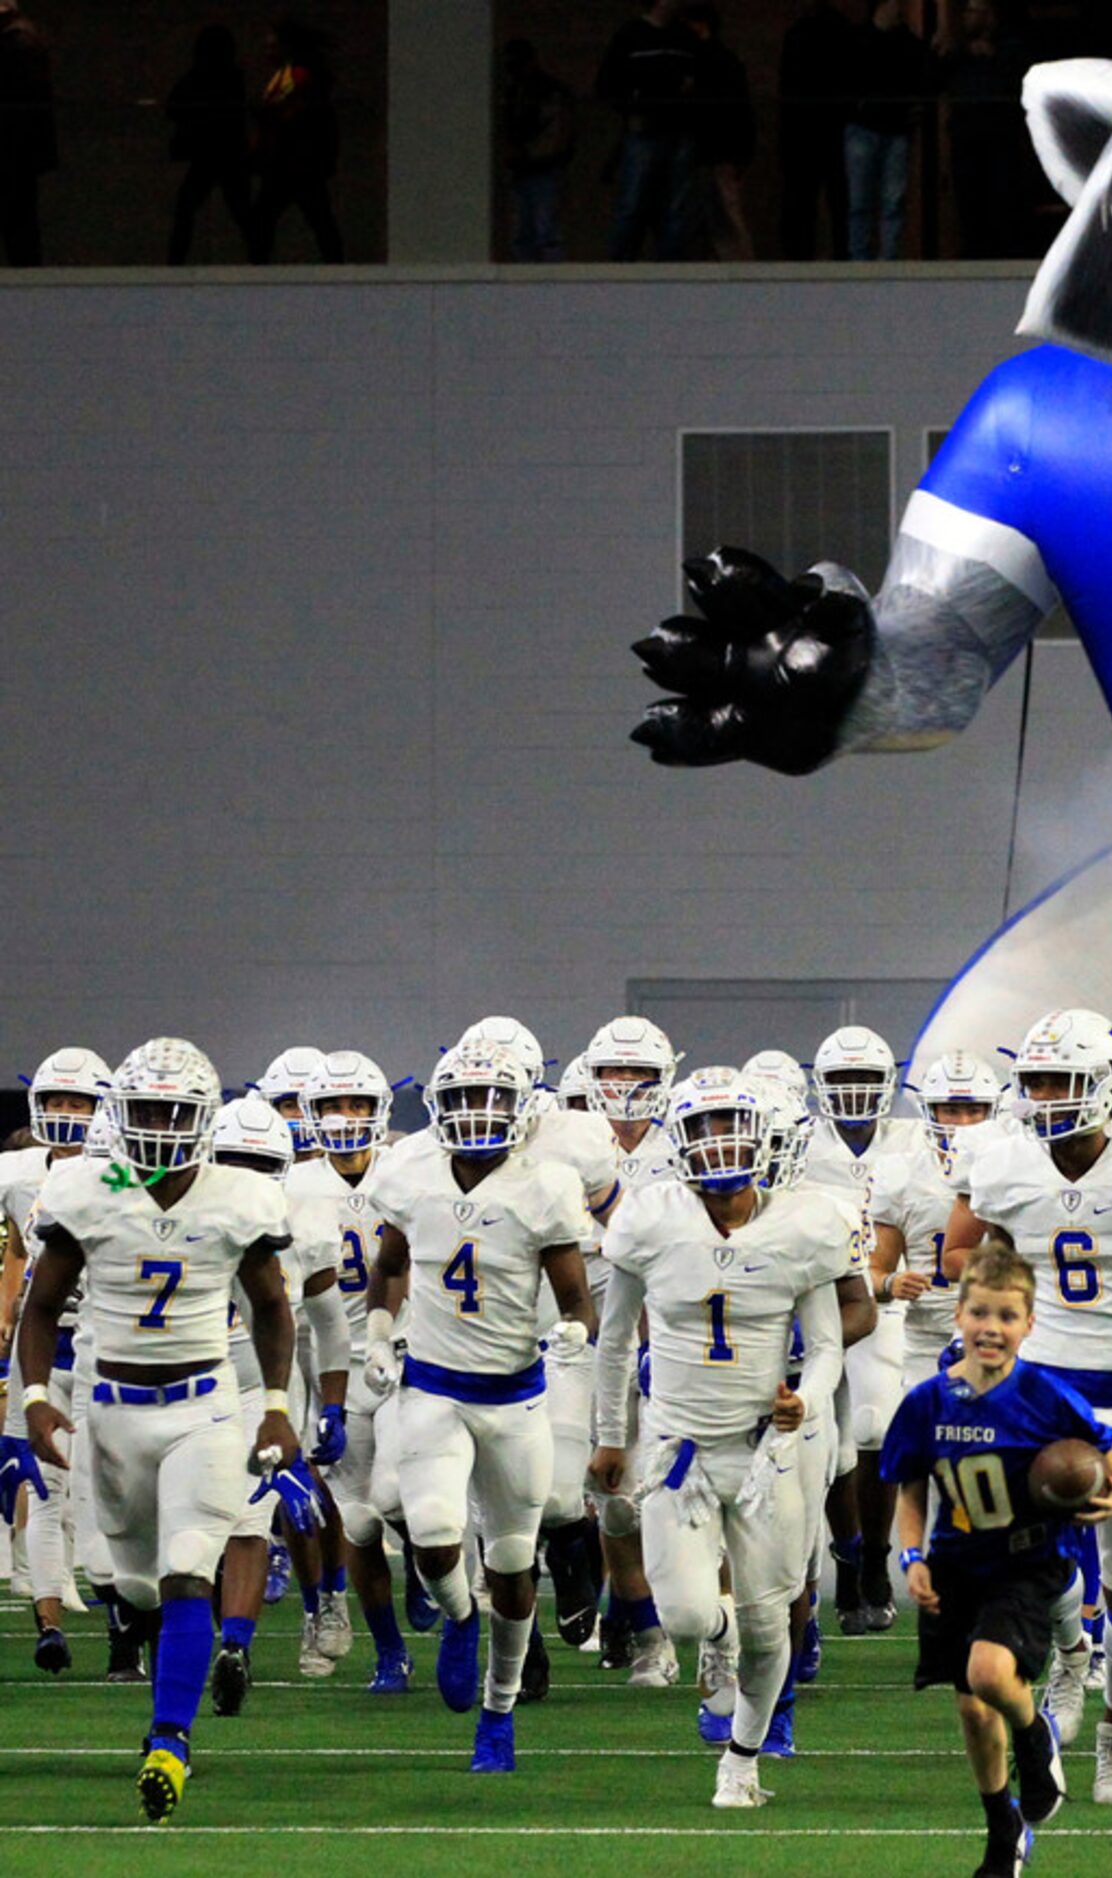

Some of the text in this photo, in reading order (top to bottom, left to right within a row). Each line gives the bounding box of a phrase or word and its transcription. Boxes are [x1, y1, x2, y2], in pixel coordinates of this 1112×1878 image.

[134, 1255, 187, 1333] 7
[440, 1237, 484, 1319] 4
[1049, 1226, 1103, 1308] 6
[703, 1287, 738, 1366] 1
[934, 1425, 996, 1444] FRISCO
[934, 1454, 1015, 1534] 10
